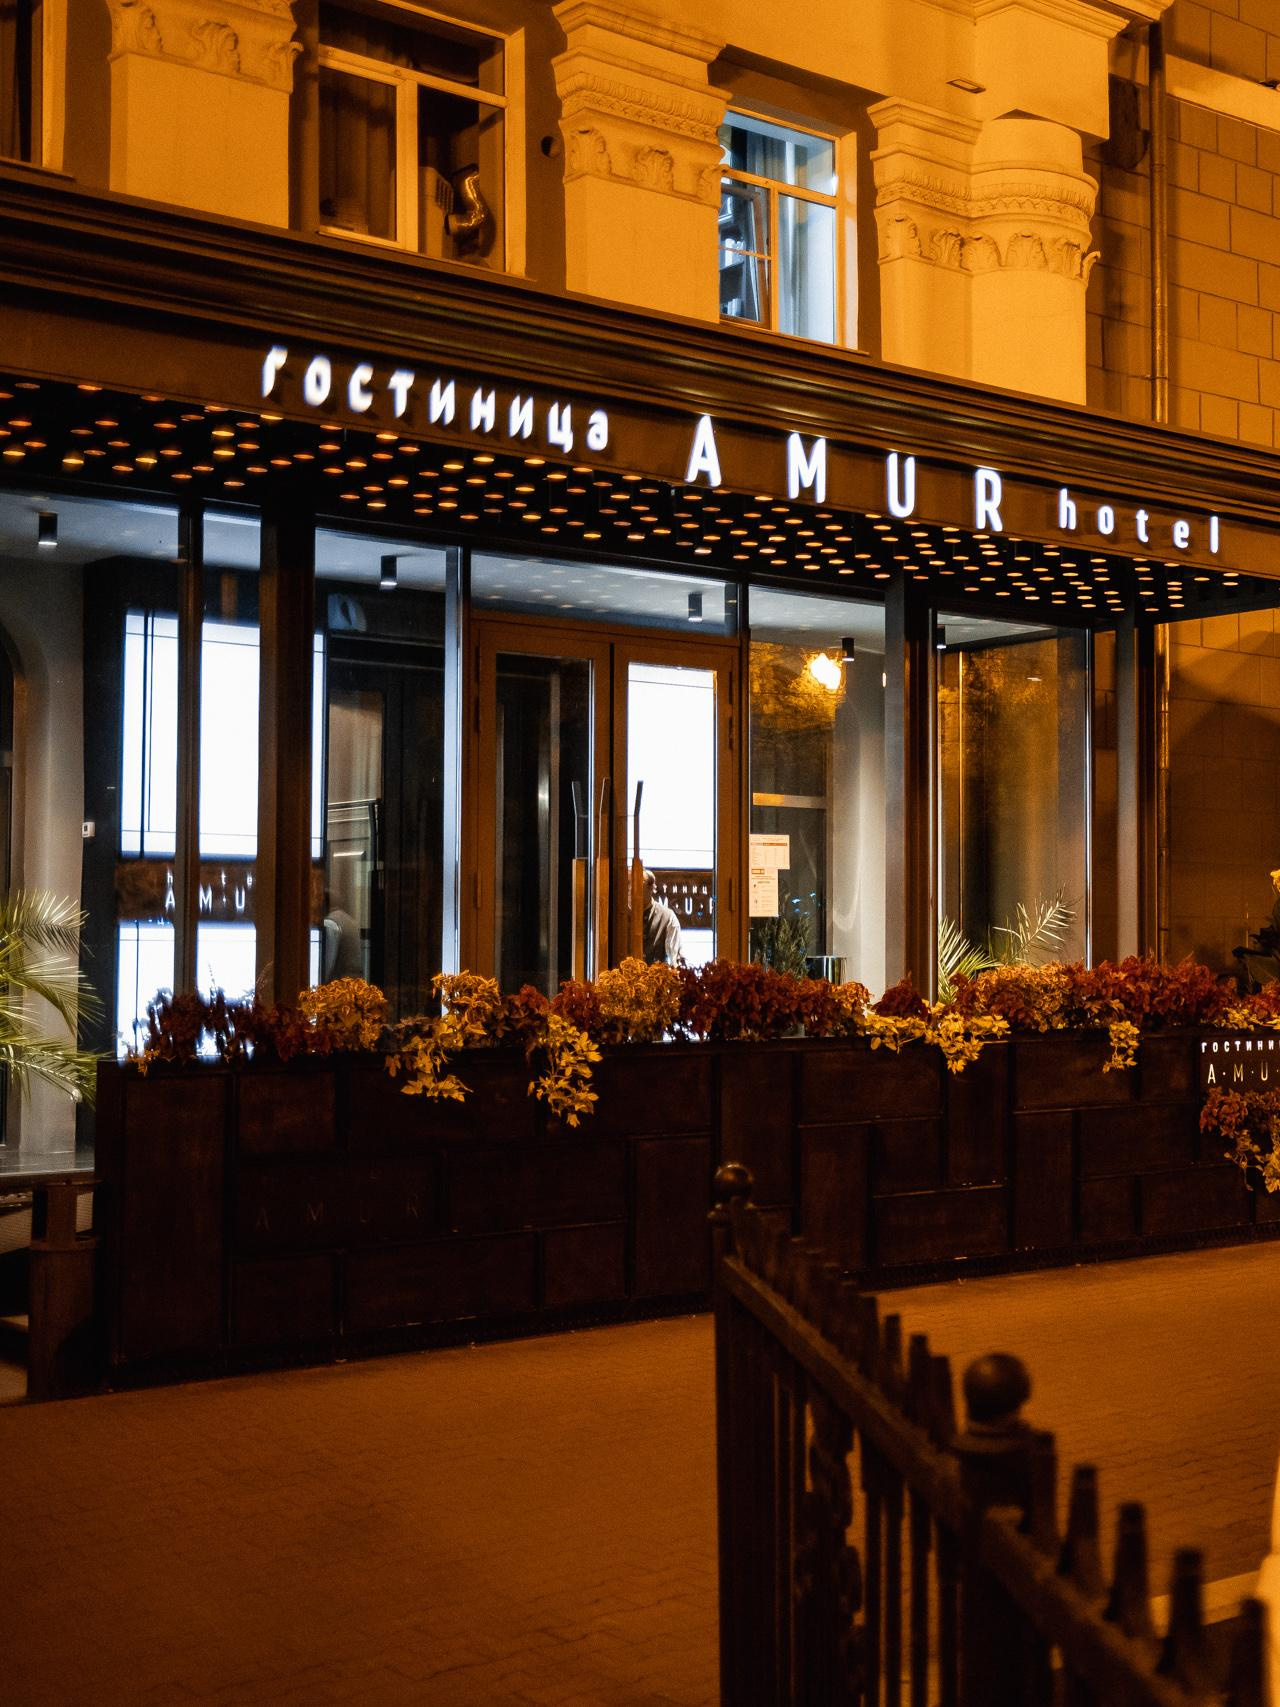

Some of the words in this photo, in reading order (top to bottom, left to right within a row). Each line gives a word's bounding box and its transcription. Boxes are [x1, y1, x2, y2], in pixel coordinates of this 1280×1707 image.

[261, 344, 609, 454] гостиница
[685, 413, 1004, 532] AMUR
[1058, 487, 1220, 554] hotel
